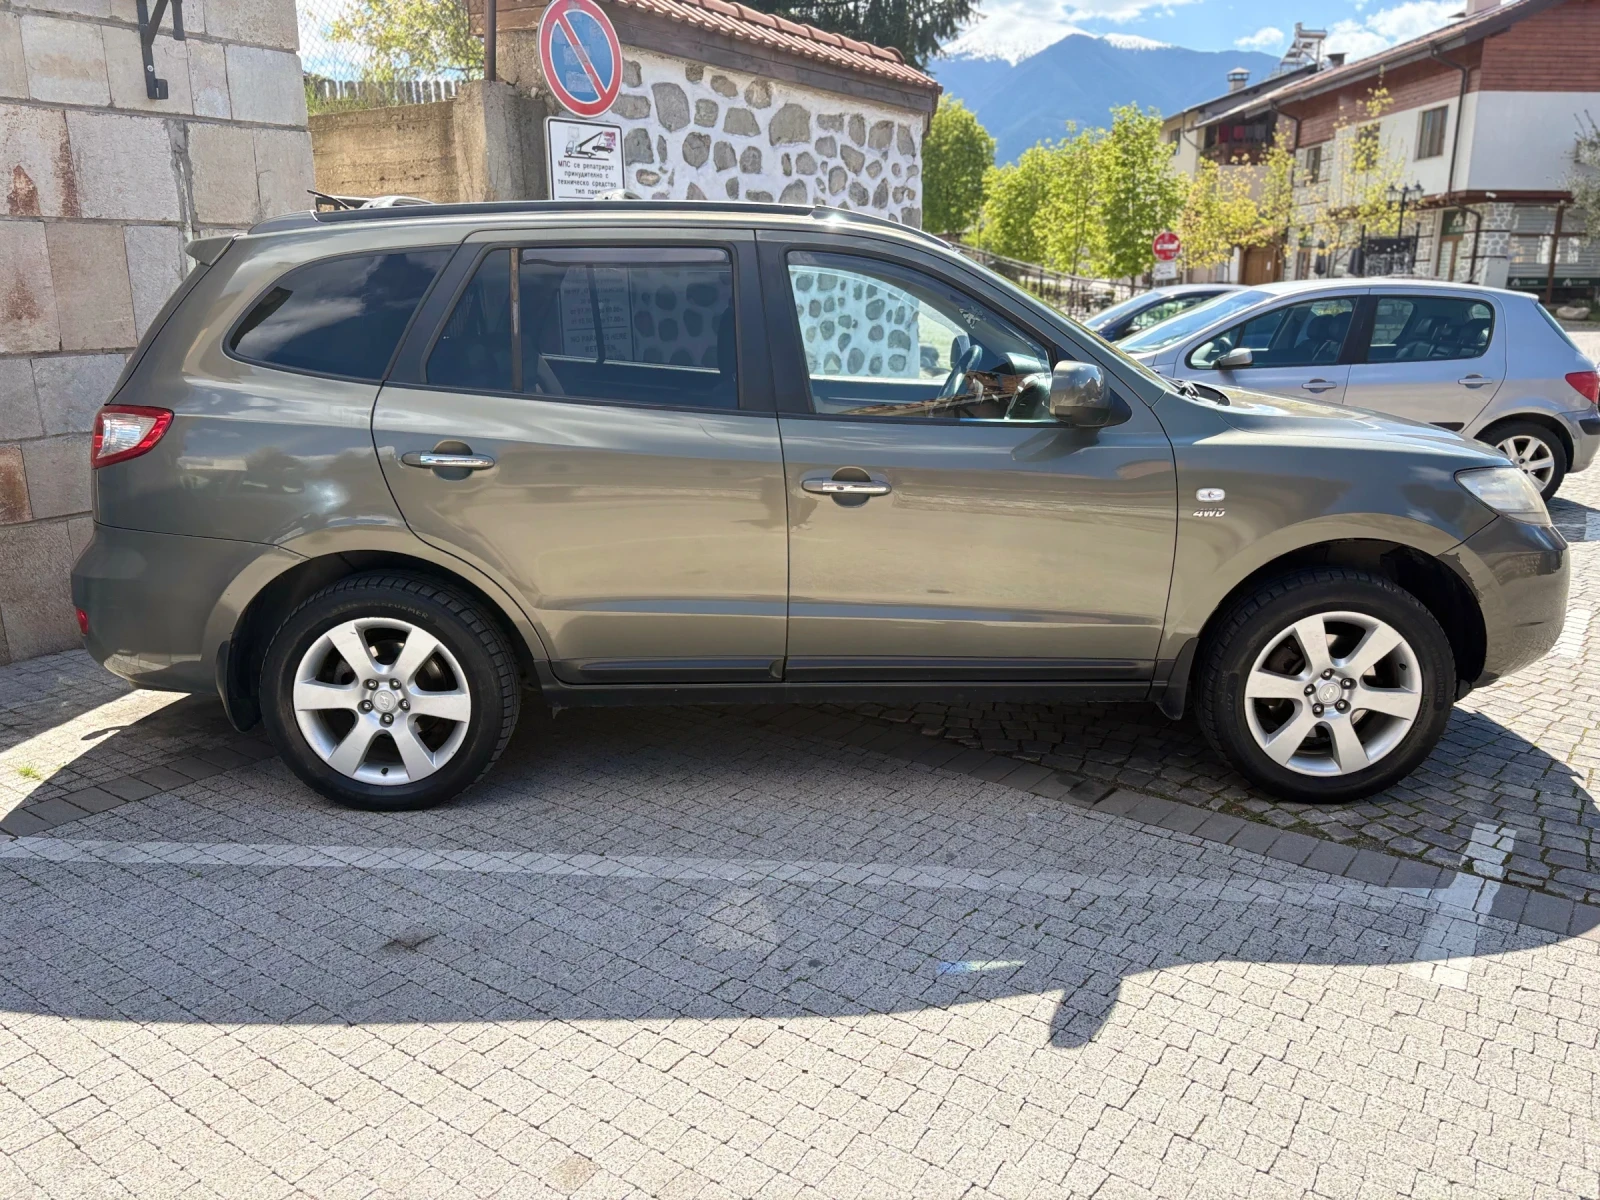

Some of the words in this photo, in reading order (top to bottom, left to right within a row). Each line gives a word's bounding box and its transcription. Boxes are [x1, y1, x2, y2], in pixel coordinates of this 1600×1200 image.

[557, 160, 571, 168] МПС
[583, 163, 614, 171] репатрират
[564, 170, 603, 179] принудително
[557, 178, 590, 187] техническо
[592, 180, 617, 188] средство
[1192, 507, 1226, 518] 4WD
